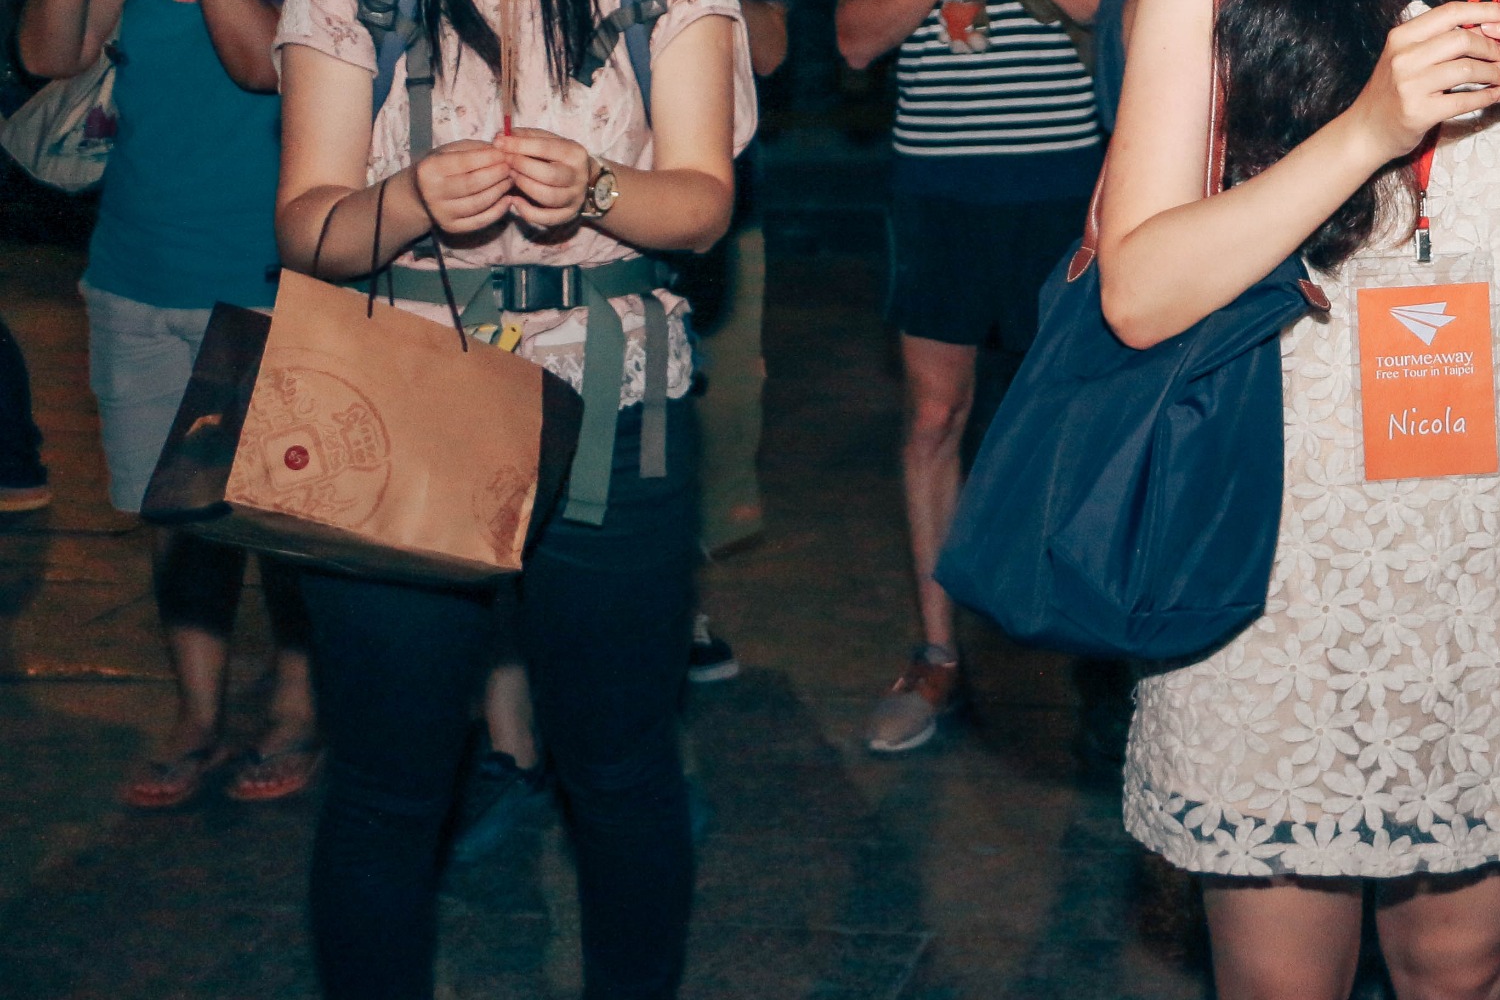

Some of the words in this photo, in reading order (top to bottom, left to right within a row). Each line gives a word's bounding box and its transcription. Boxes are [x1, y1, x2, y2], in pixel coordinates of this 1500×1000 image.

[1376, 370, 1399, 379] Free
[1402, 368, 1428, 378] Tour
[1430, 366, 1440, 377] in
[1443, 363, 1474, 377] Taipei
[1389, 406, 1466, 440] Nicola
